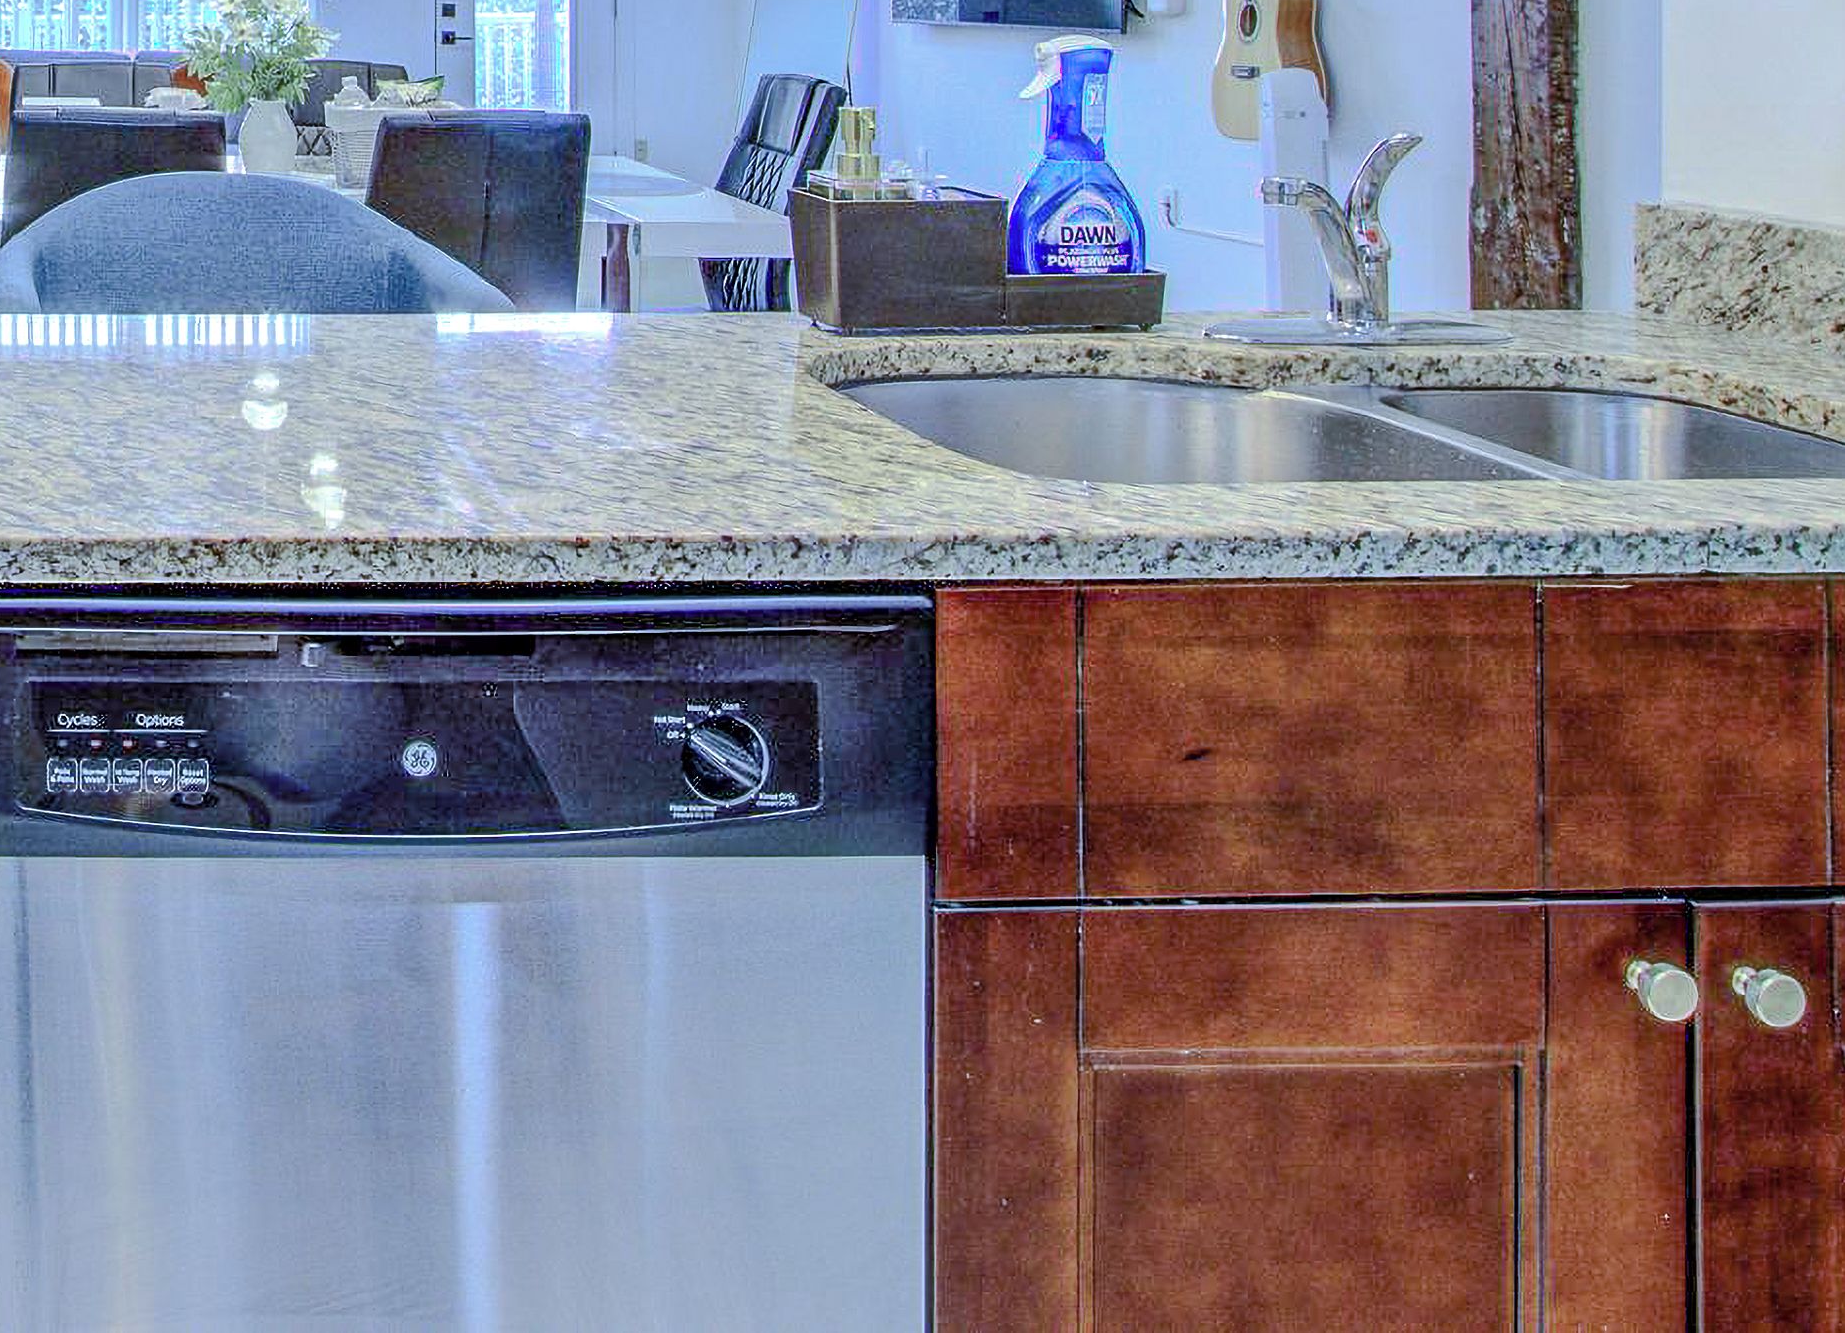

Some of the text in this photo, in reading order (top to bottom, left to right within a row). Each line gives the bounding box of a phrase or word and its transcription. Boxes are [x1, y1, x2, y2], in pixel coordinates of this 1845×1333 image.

[1060, 226, 1117, 243] DAWN
[57, 713, 98, 728] Cycles
[135, 713, 185, 728] Options
